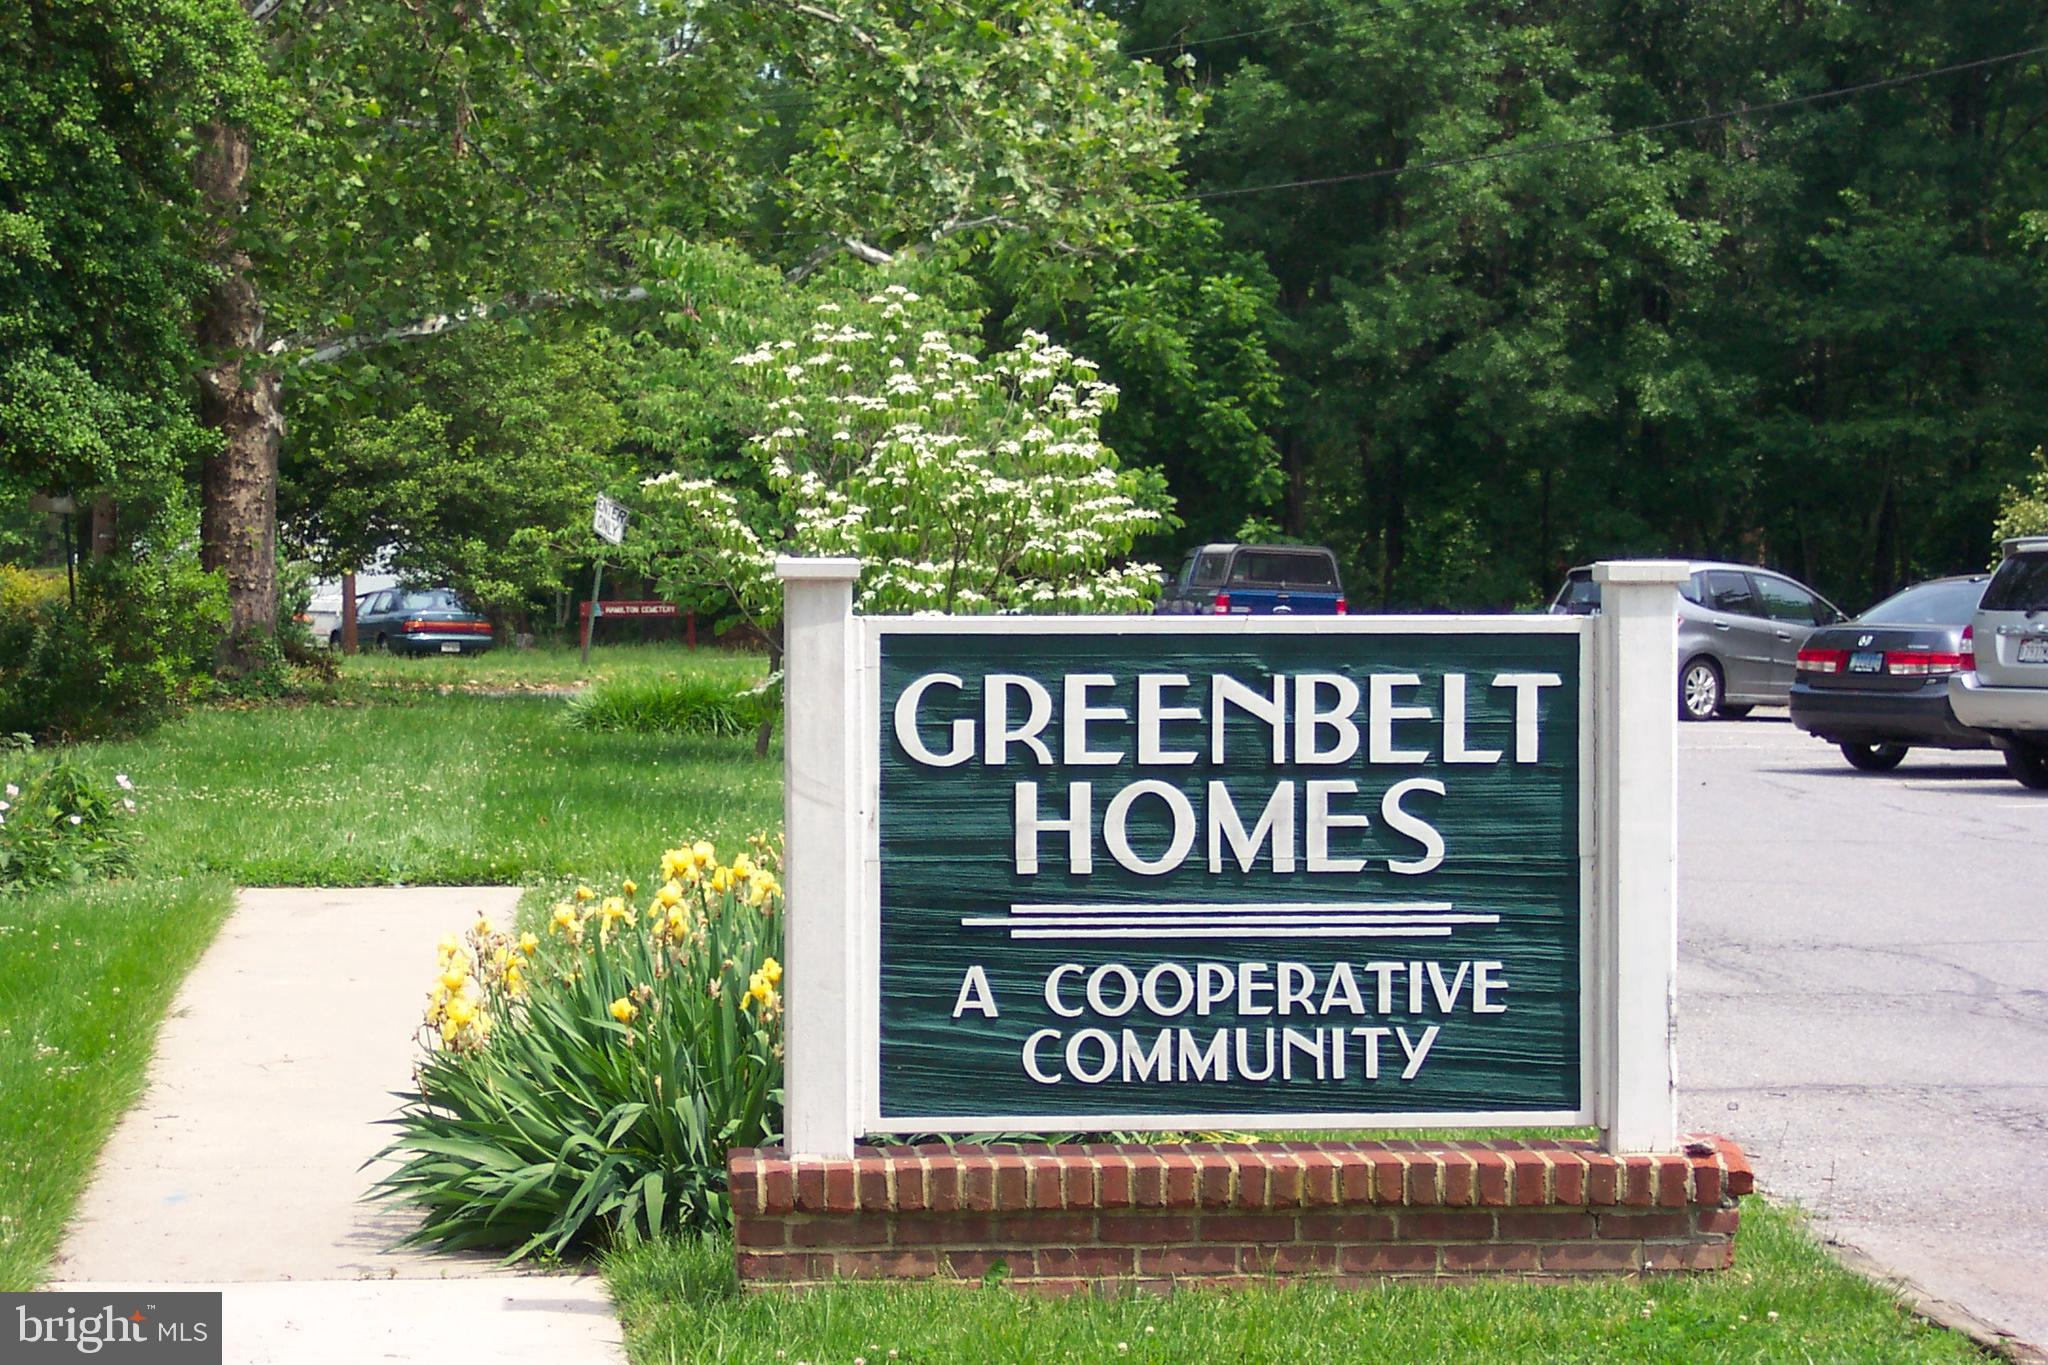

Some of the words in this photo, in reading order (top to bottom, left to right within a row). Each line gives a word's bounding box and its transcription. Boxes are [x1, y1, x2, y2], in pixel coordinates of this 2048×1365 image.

[597, 497, 627, 524] ENTER
[597, 514, 619, 537] ONLY
[605, 605, 639, 614] HAMILTON
[641, 605, 676, 614] CEMETERY
[893, 672, 1562, 767] GREENBELT
[1014, 777, 1446, 876] HOMES
[952, 965, 998, 1019] A
[1044, 960, 1509, 1018] COOPERATIVE
[1021, 1025, 1440, 1084] COMMUNITY
